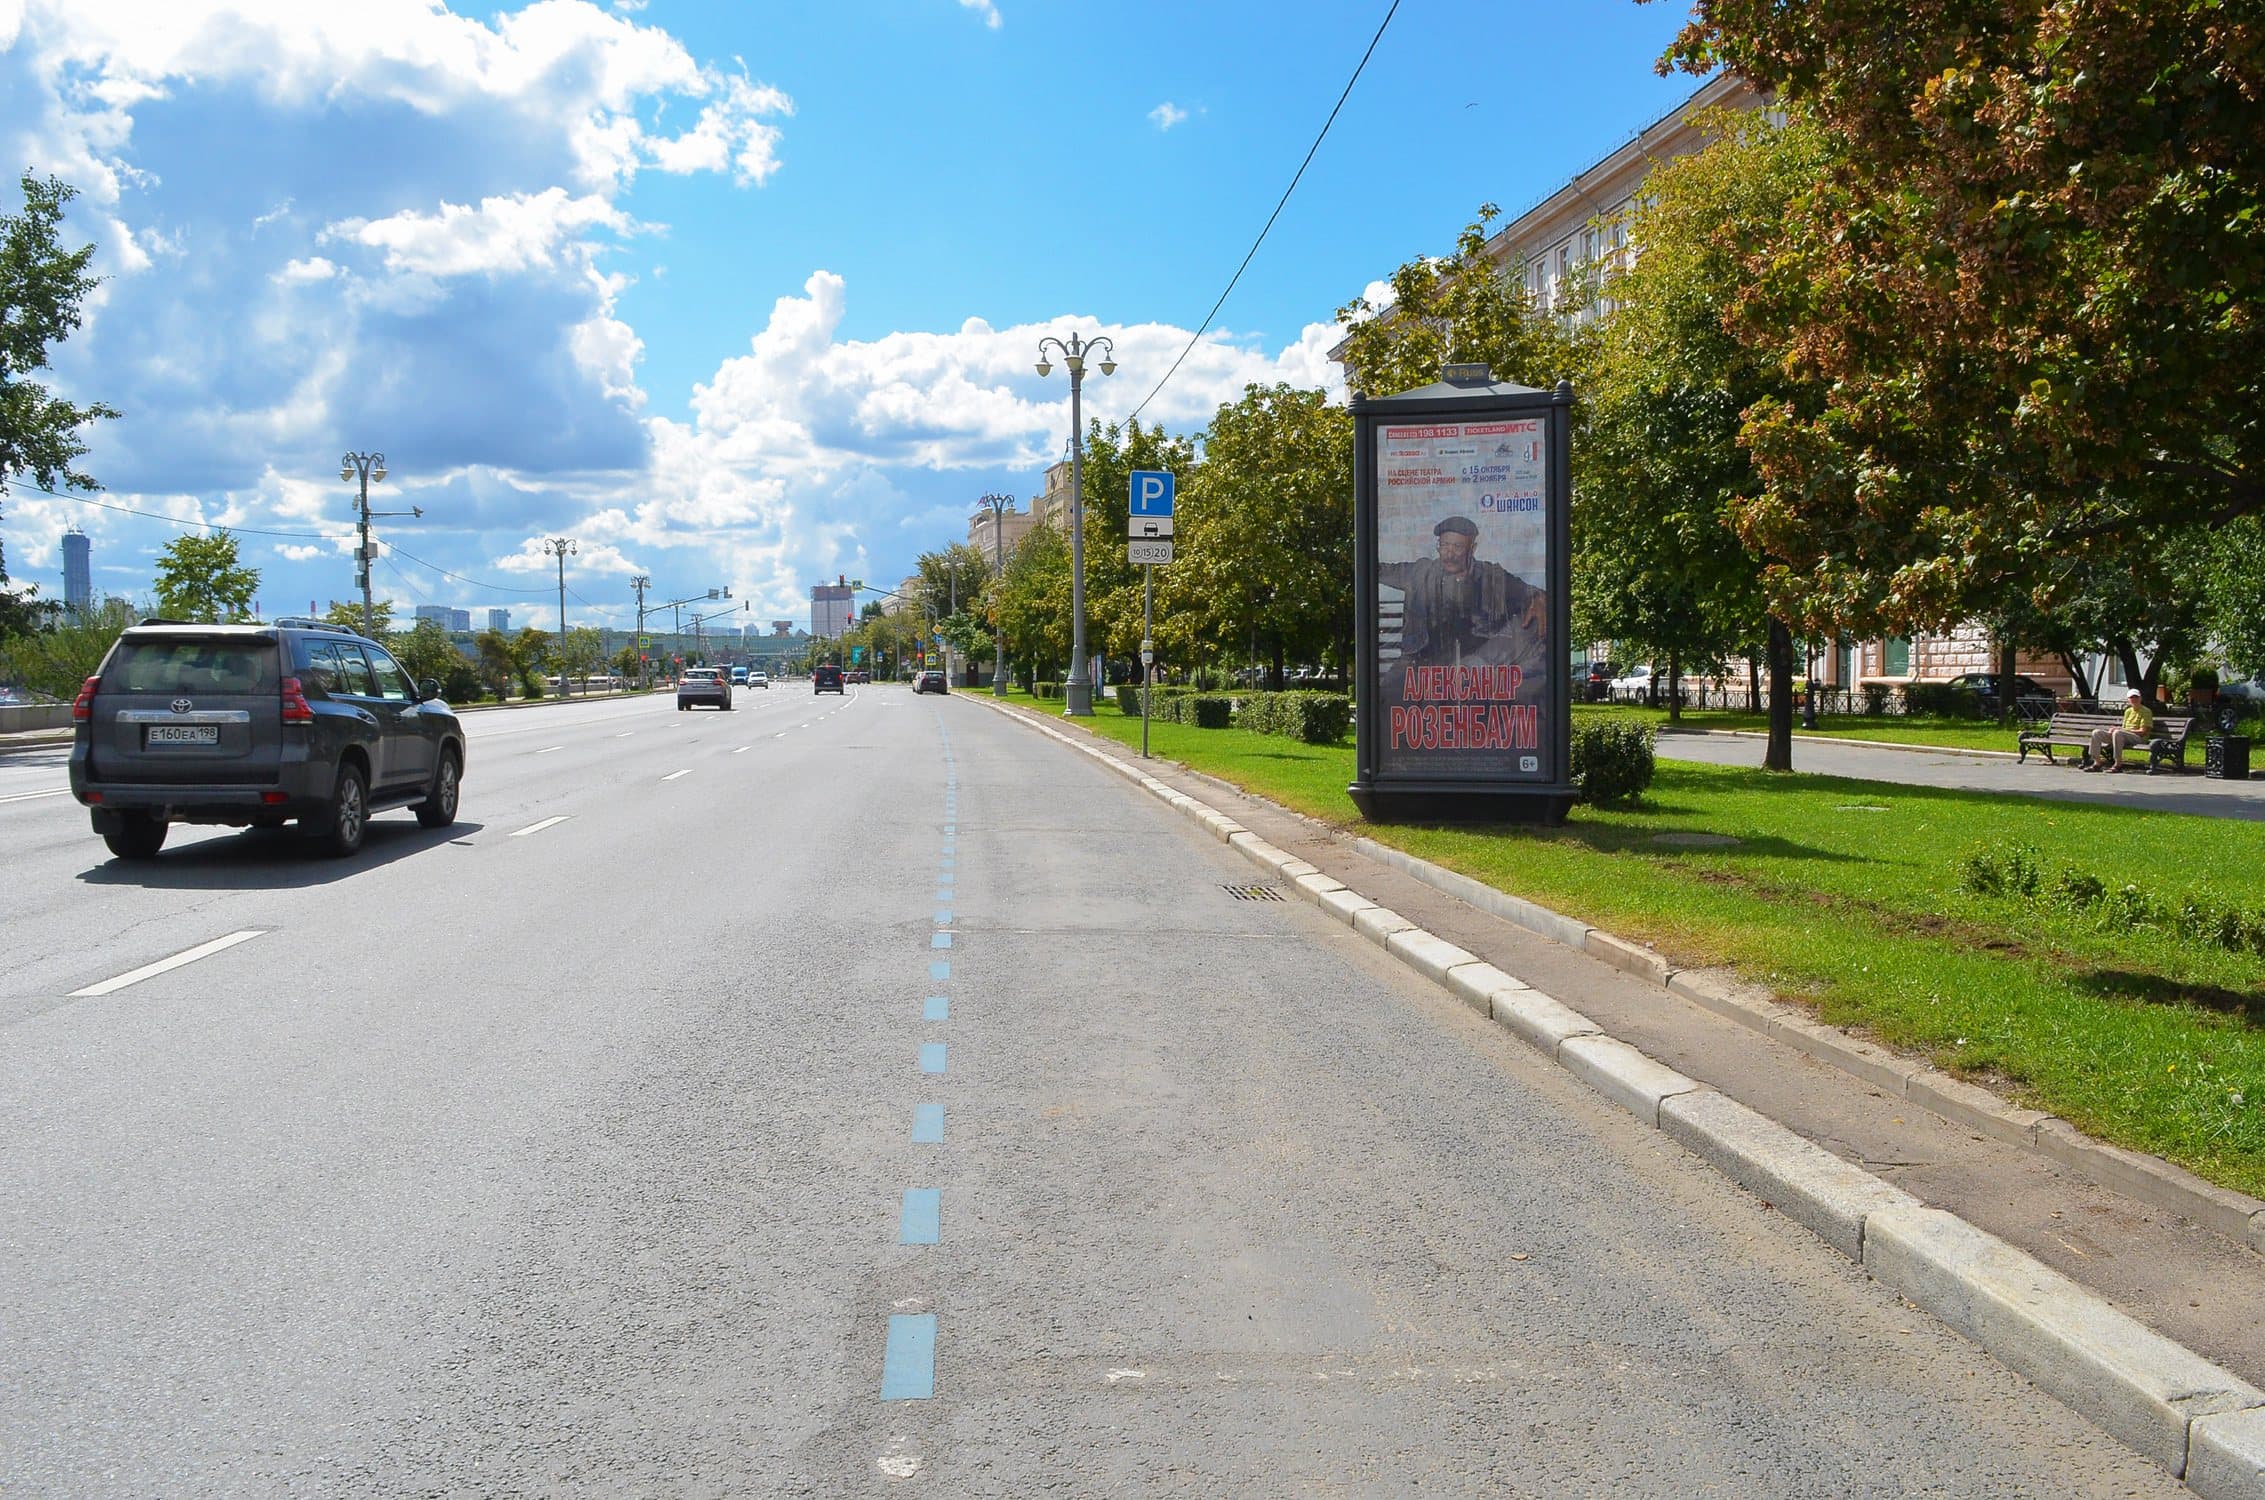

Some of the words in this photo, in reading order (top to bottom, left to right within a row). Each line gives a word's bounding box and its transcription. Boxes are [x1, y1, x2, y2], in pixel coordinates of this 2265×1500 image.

[1421, 468, 1442, 476] ТЕАТРА
[1470, 466, 1479, 474] 15
[1481, 465, 1511, 473] ОКТЯБРЯ
[1388, 477, 1431, 486] РОССИЙСКОЙ
[1473, 475, 1479, 483] 2
[1480, 474, 1507, 482] НОЯБРЯ
[1142, 477, 1164, 510] P
[1497, 498, 1538, 512] ШАНСОН
[1143, 548, 1151, 557] 15
[1154, 548, 1167, 558] 20
[1403, 664, 1522, 701] АЛЕКСАНДР
[1390, 704, 1538, 750] РОЗЕНБАУМ
[1522, 759, 1536, 769] 6+
